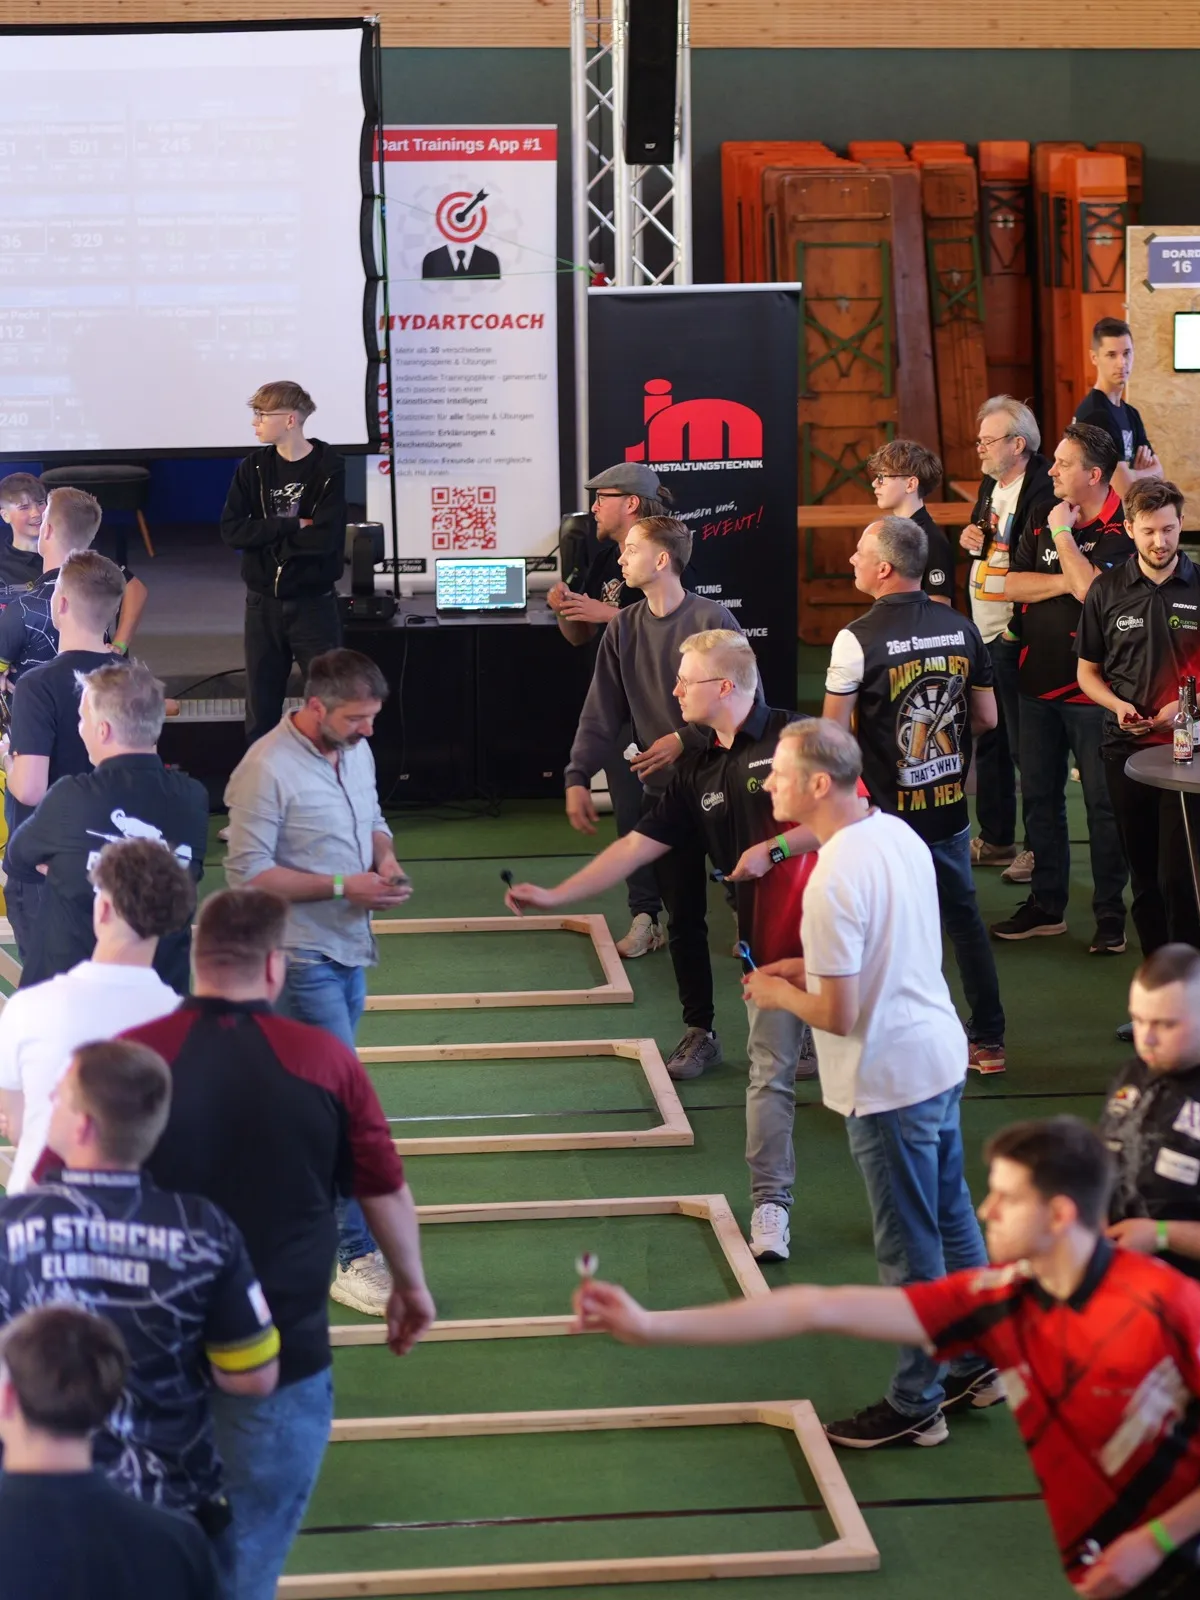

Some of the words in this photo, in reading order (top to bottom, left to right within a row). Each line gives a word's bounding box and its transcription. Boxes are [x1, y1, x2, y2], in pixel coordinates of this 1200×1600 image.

[376, 138, 409, 151] Dart
[412, 138, 484, 154] Trainings
[488, 139, 520, 153] App
[523, 138, 542, 151] #1
[1172, 260, 1193, 273] 16
[644, 460, 763, 472] ANSTALTUNGSTECHNIK
[702, 505, 763, 540] EVENT!
[695, 584, 722, 594] TUNG
[741, 627, 768, 637] RVICE
[888, 659, 922, 702] DARTS
[924, 655, 946, 672] AND
[936, 757, 958, 775] WHY
